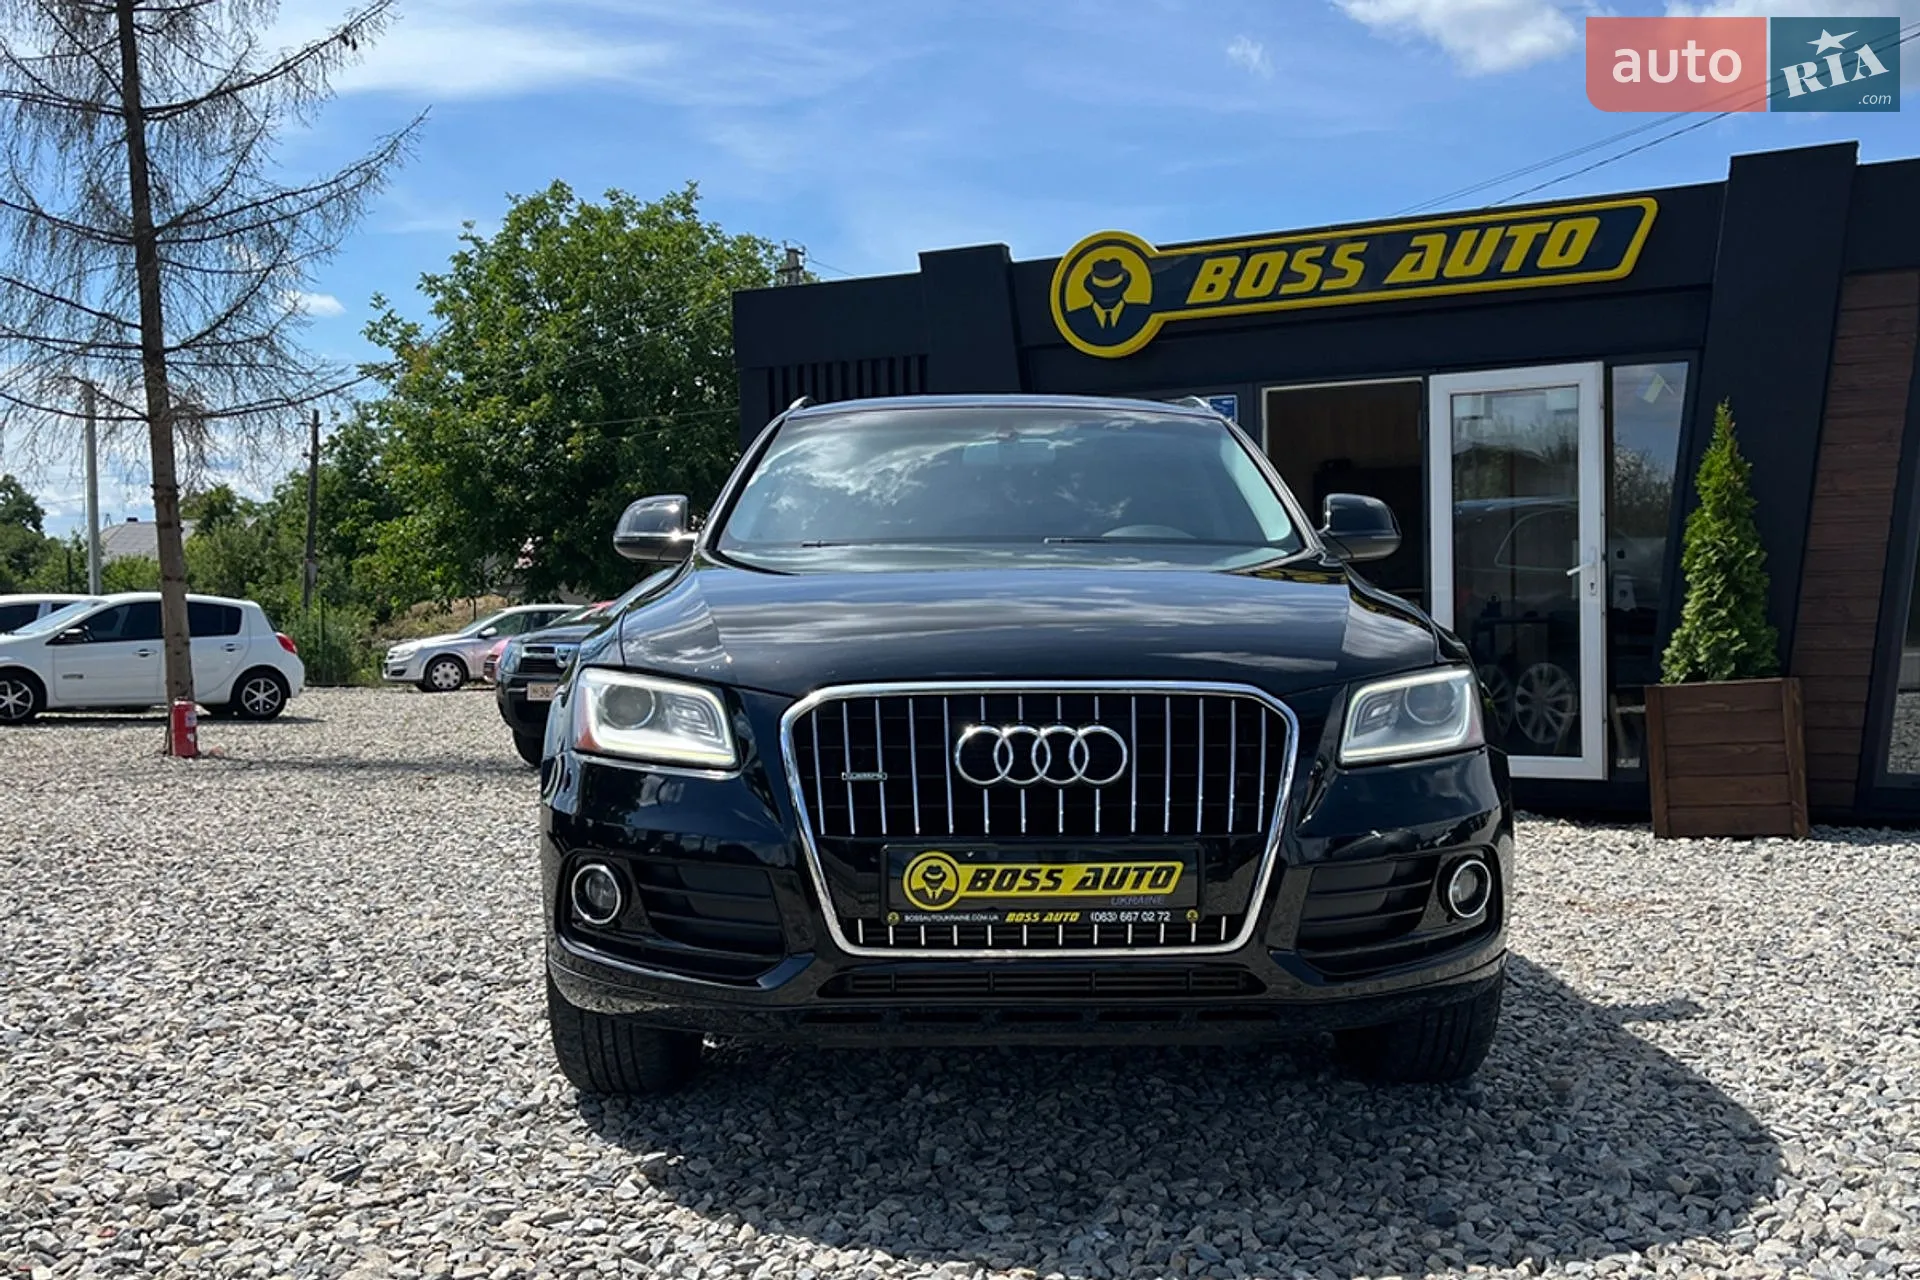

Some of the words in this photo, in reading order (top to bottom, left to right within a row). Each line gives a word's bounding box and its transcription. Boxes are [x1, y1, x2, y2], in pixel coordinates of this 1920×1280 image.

[1186, 241, 1369, 304] BOSS
[1383, 216, 1601, 284] AUTO
[965, 868, 1064, 892] BOSS
[1073, 865, 1176, 891] AUTO
[1005, 912, 1040, 923] BOSS
[1043, 911, 1080, 923] AUTO
[1141, 911, 1155, 922] 02
[1156, 911, 1171, 922] 72
